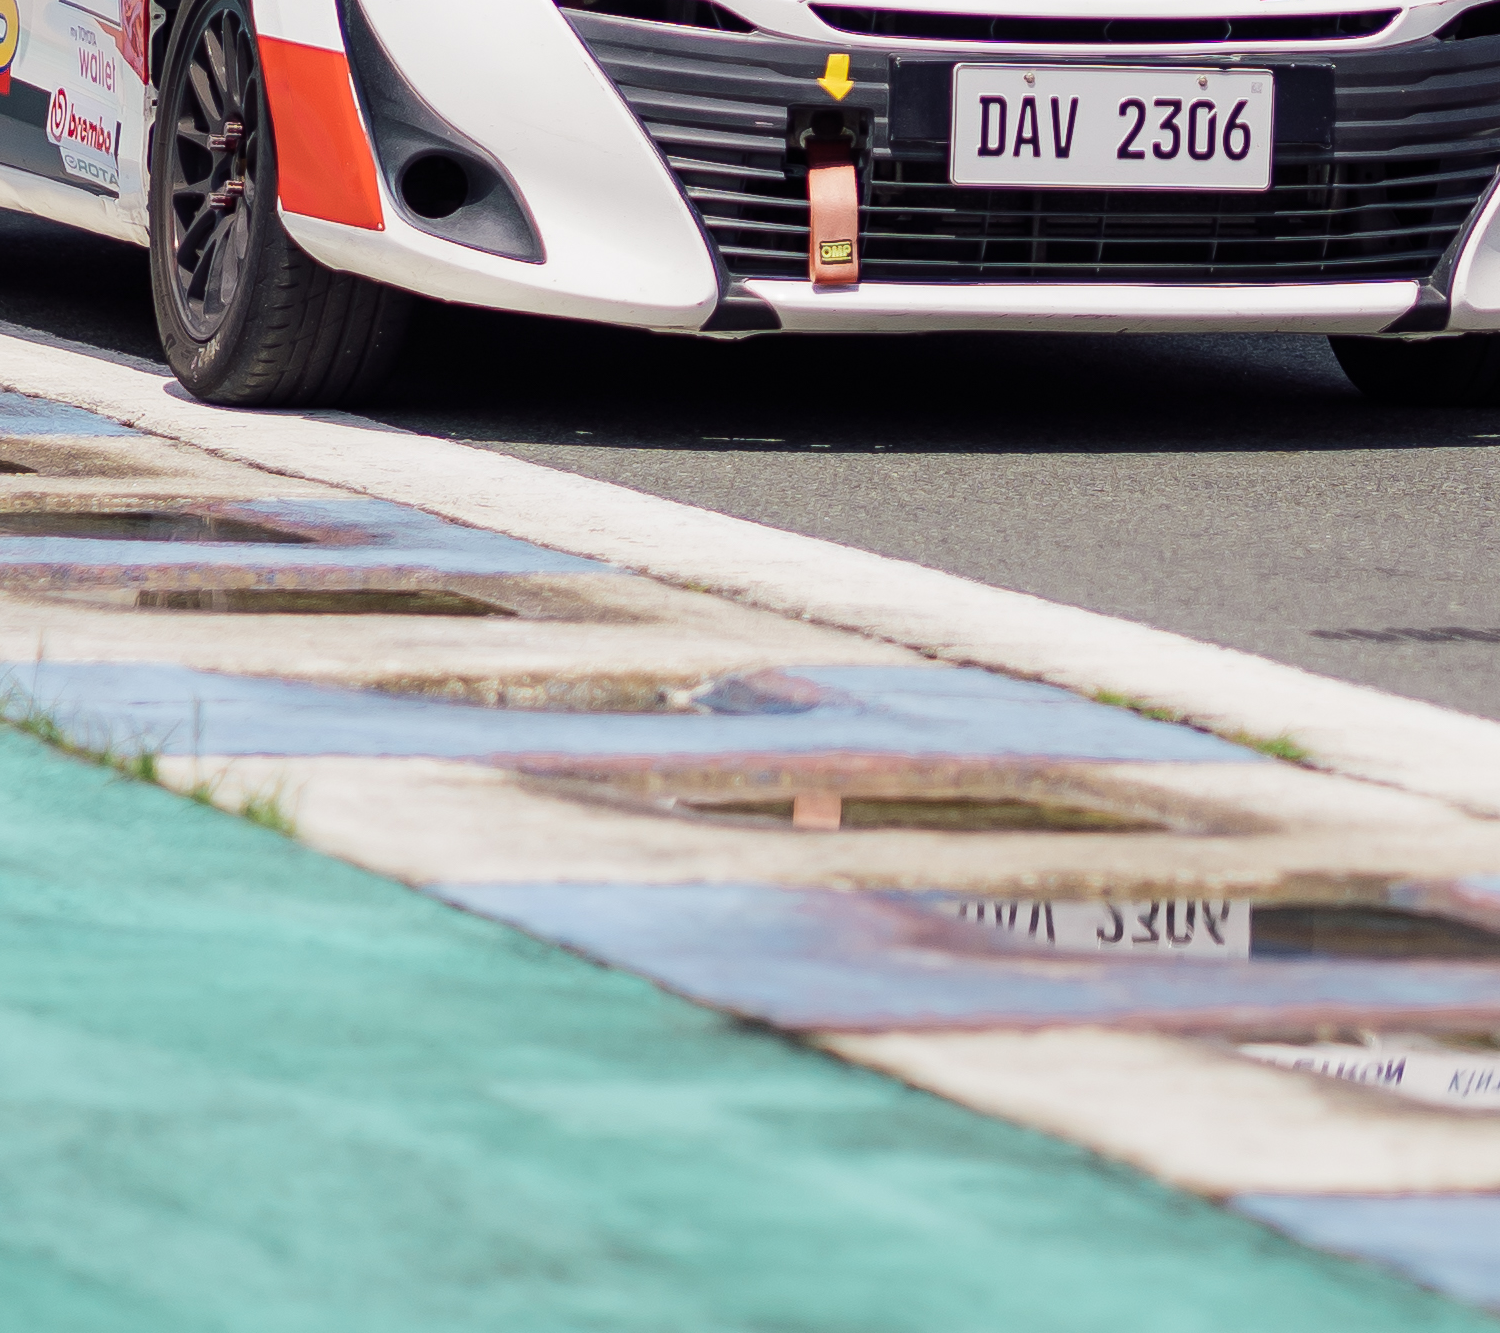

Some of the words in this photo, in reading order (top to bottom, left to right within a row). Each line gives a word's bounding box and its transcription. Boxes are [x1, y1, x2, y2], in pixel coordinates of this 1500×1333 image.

[78, 47, 116, 93] wallet
[68, 103, 111, 155] brembo
[977, 94, 1079, 159] DAV
[1116, 97, 1252, 161] 2306
[77, 159, 119, 186] ROTA
[821, 243, 852, 258] OMP
